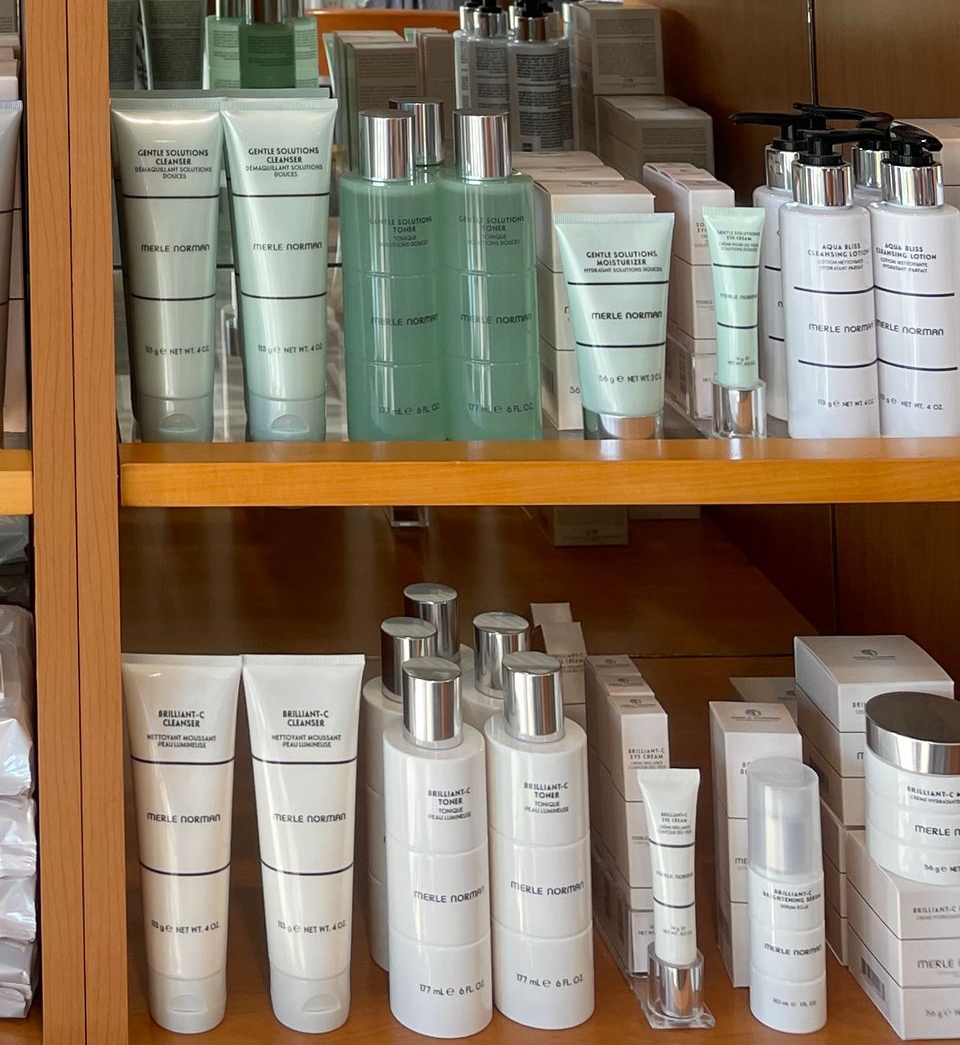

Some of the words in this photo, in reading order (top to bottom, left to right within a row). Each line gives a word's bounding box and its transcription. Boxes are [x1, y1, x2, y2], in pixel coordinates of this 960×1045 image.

[138, 149, 165, 157] GENTLE
[276, 147, 319, 155] SOLUTIONS
[266, 156, 303, 164] CLEANSER
[393, 225, 416, 233] TONER
[141, 244, 170, 252] MERLE
[173, 243, 210, 252] NORMAN
[253, 243, 282, 251] MERLE
[286, 242, 322, 250] NORMAN
[905, 245, 924, 253] BLISS
[848, 249, 869, 257] LOTION
[591, 312, 623, 320] MERLE
[625, 311, 663, 320] NORMAN
[902, 327, 944, 336] NORMAN
[158, 710, 205, 719] BRILLIANT-C
[282, 710, 329, 719] BRILLIANT-C
[162, 719, 200, 728] CLEANSER
[287, 719, 325, 727] CLEANSER
[524, 782, 568, 790] BRILLIANT-C
[534, 791, 560, 799] TONER
[438, 797, 463, 806] TONER
[147, 813, 178, 823] MERLE
[180, 814, 221, 824] NORMAN
[516, 974, 528, 983] 177
[555, 979, 561, 988] 6
